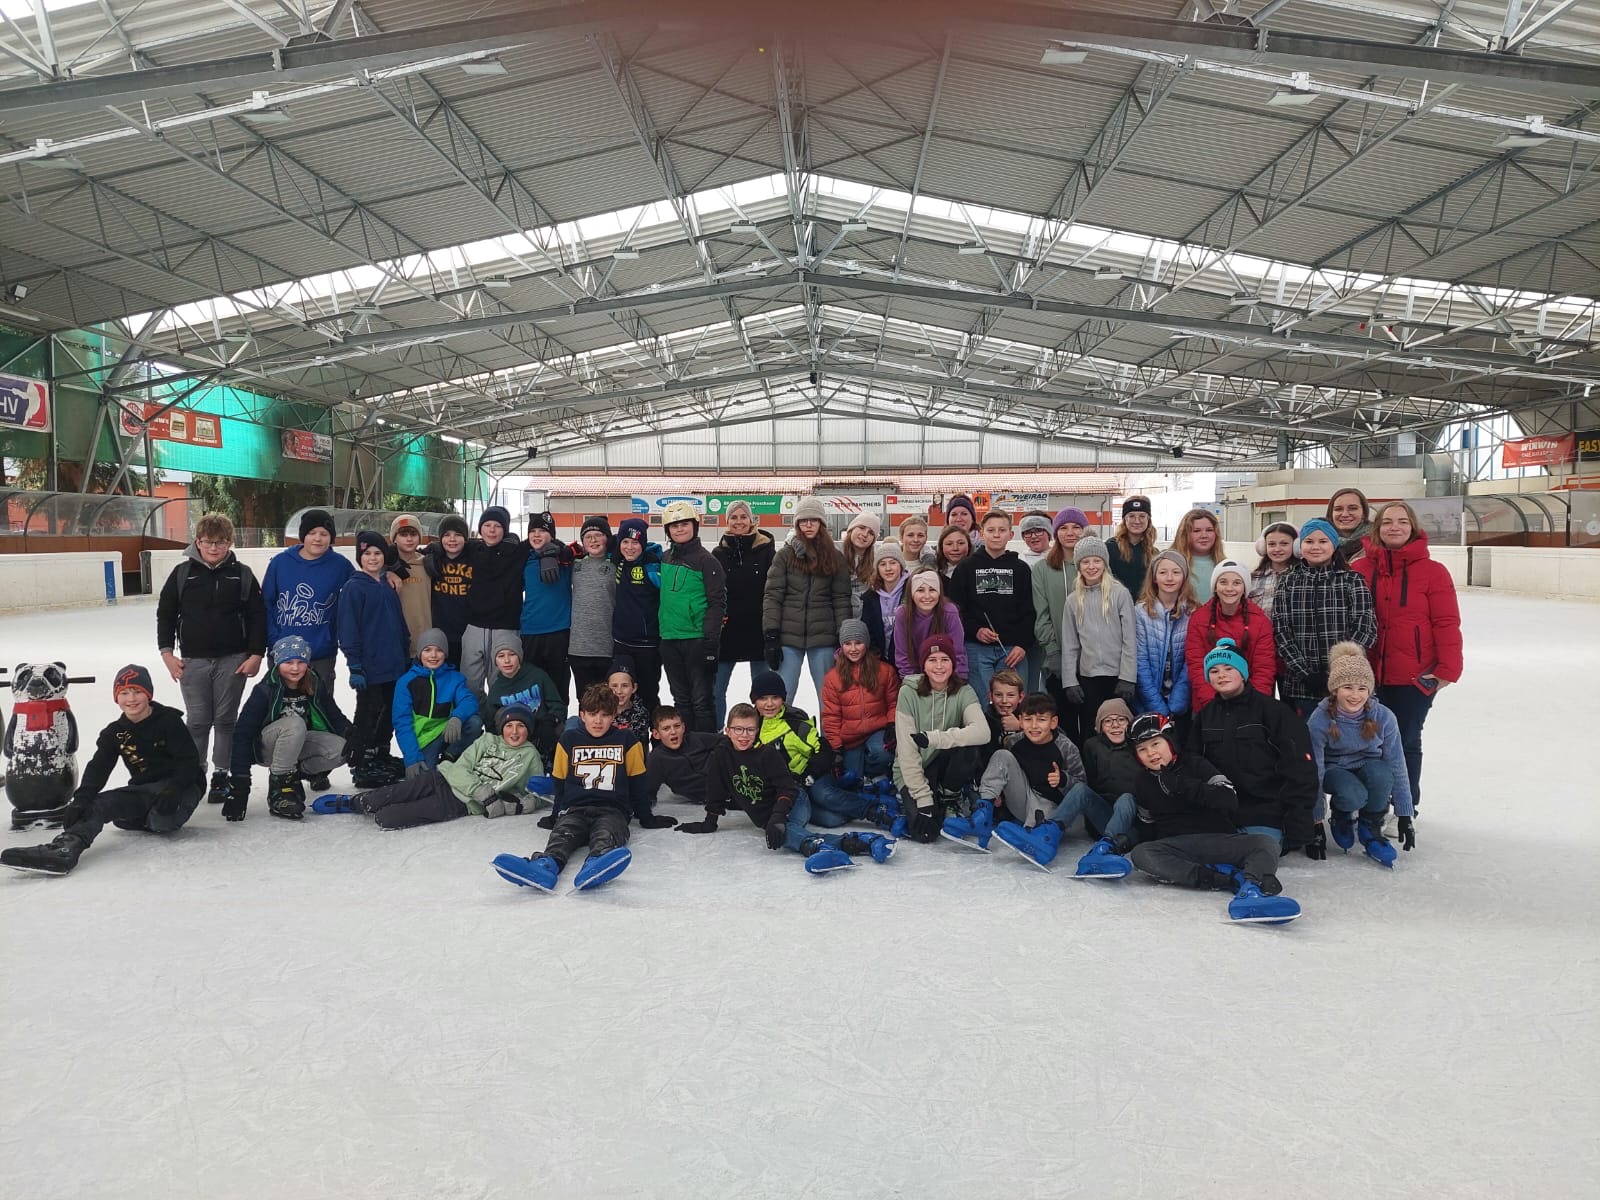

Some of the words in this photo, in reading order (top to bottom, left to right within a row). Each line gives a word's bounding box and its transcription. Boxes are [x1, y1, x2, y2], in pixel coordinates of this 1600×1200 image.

[434, 582, 471, 596] JONE
[573, 747, 622, 763] FLYHIGH
[576, 764, 614, 791] 71
